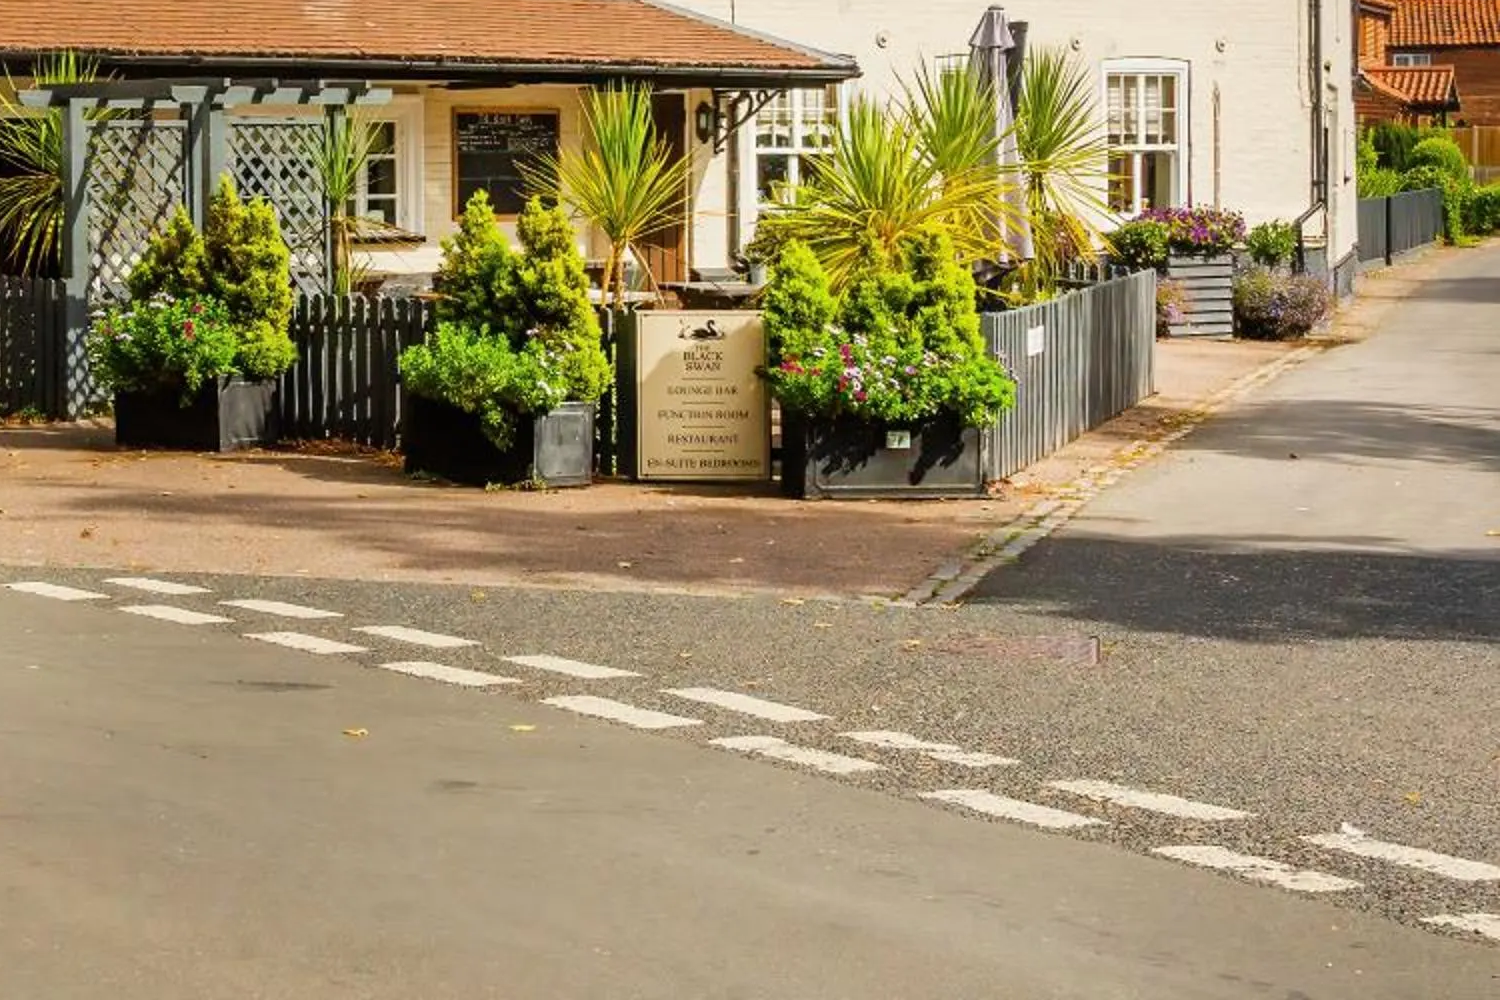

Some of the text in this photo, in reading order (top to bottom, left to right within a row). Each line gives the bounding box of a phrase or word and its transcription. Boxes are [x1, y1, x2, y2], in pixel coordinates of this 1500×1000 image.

[683, 352, 724, 361] BLACK
[685, 362, 721, 371] SWAN
[667, 386, 739, 395] LOUNGE BAR
[658, 409, 749, 419] FUNCTION ROOM
[667, 435, 739, 444] RESTAURANT
